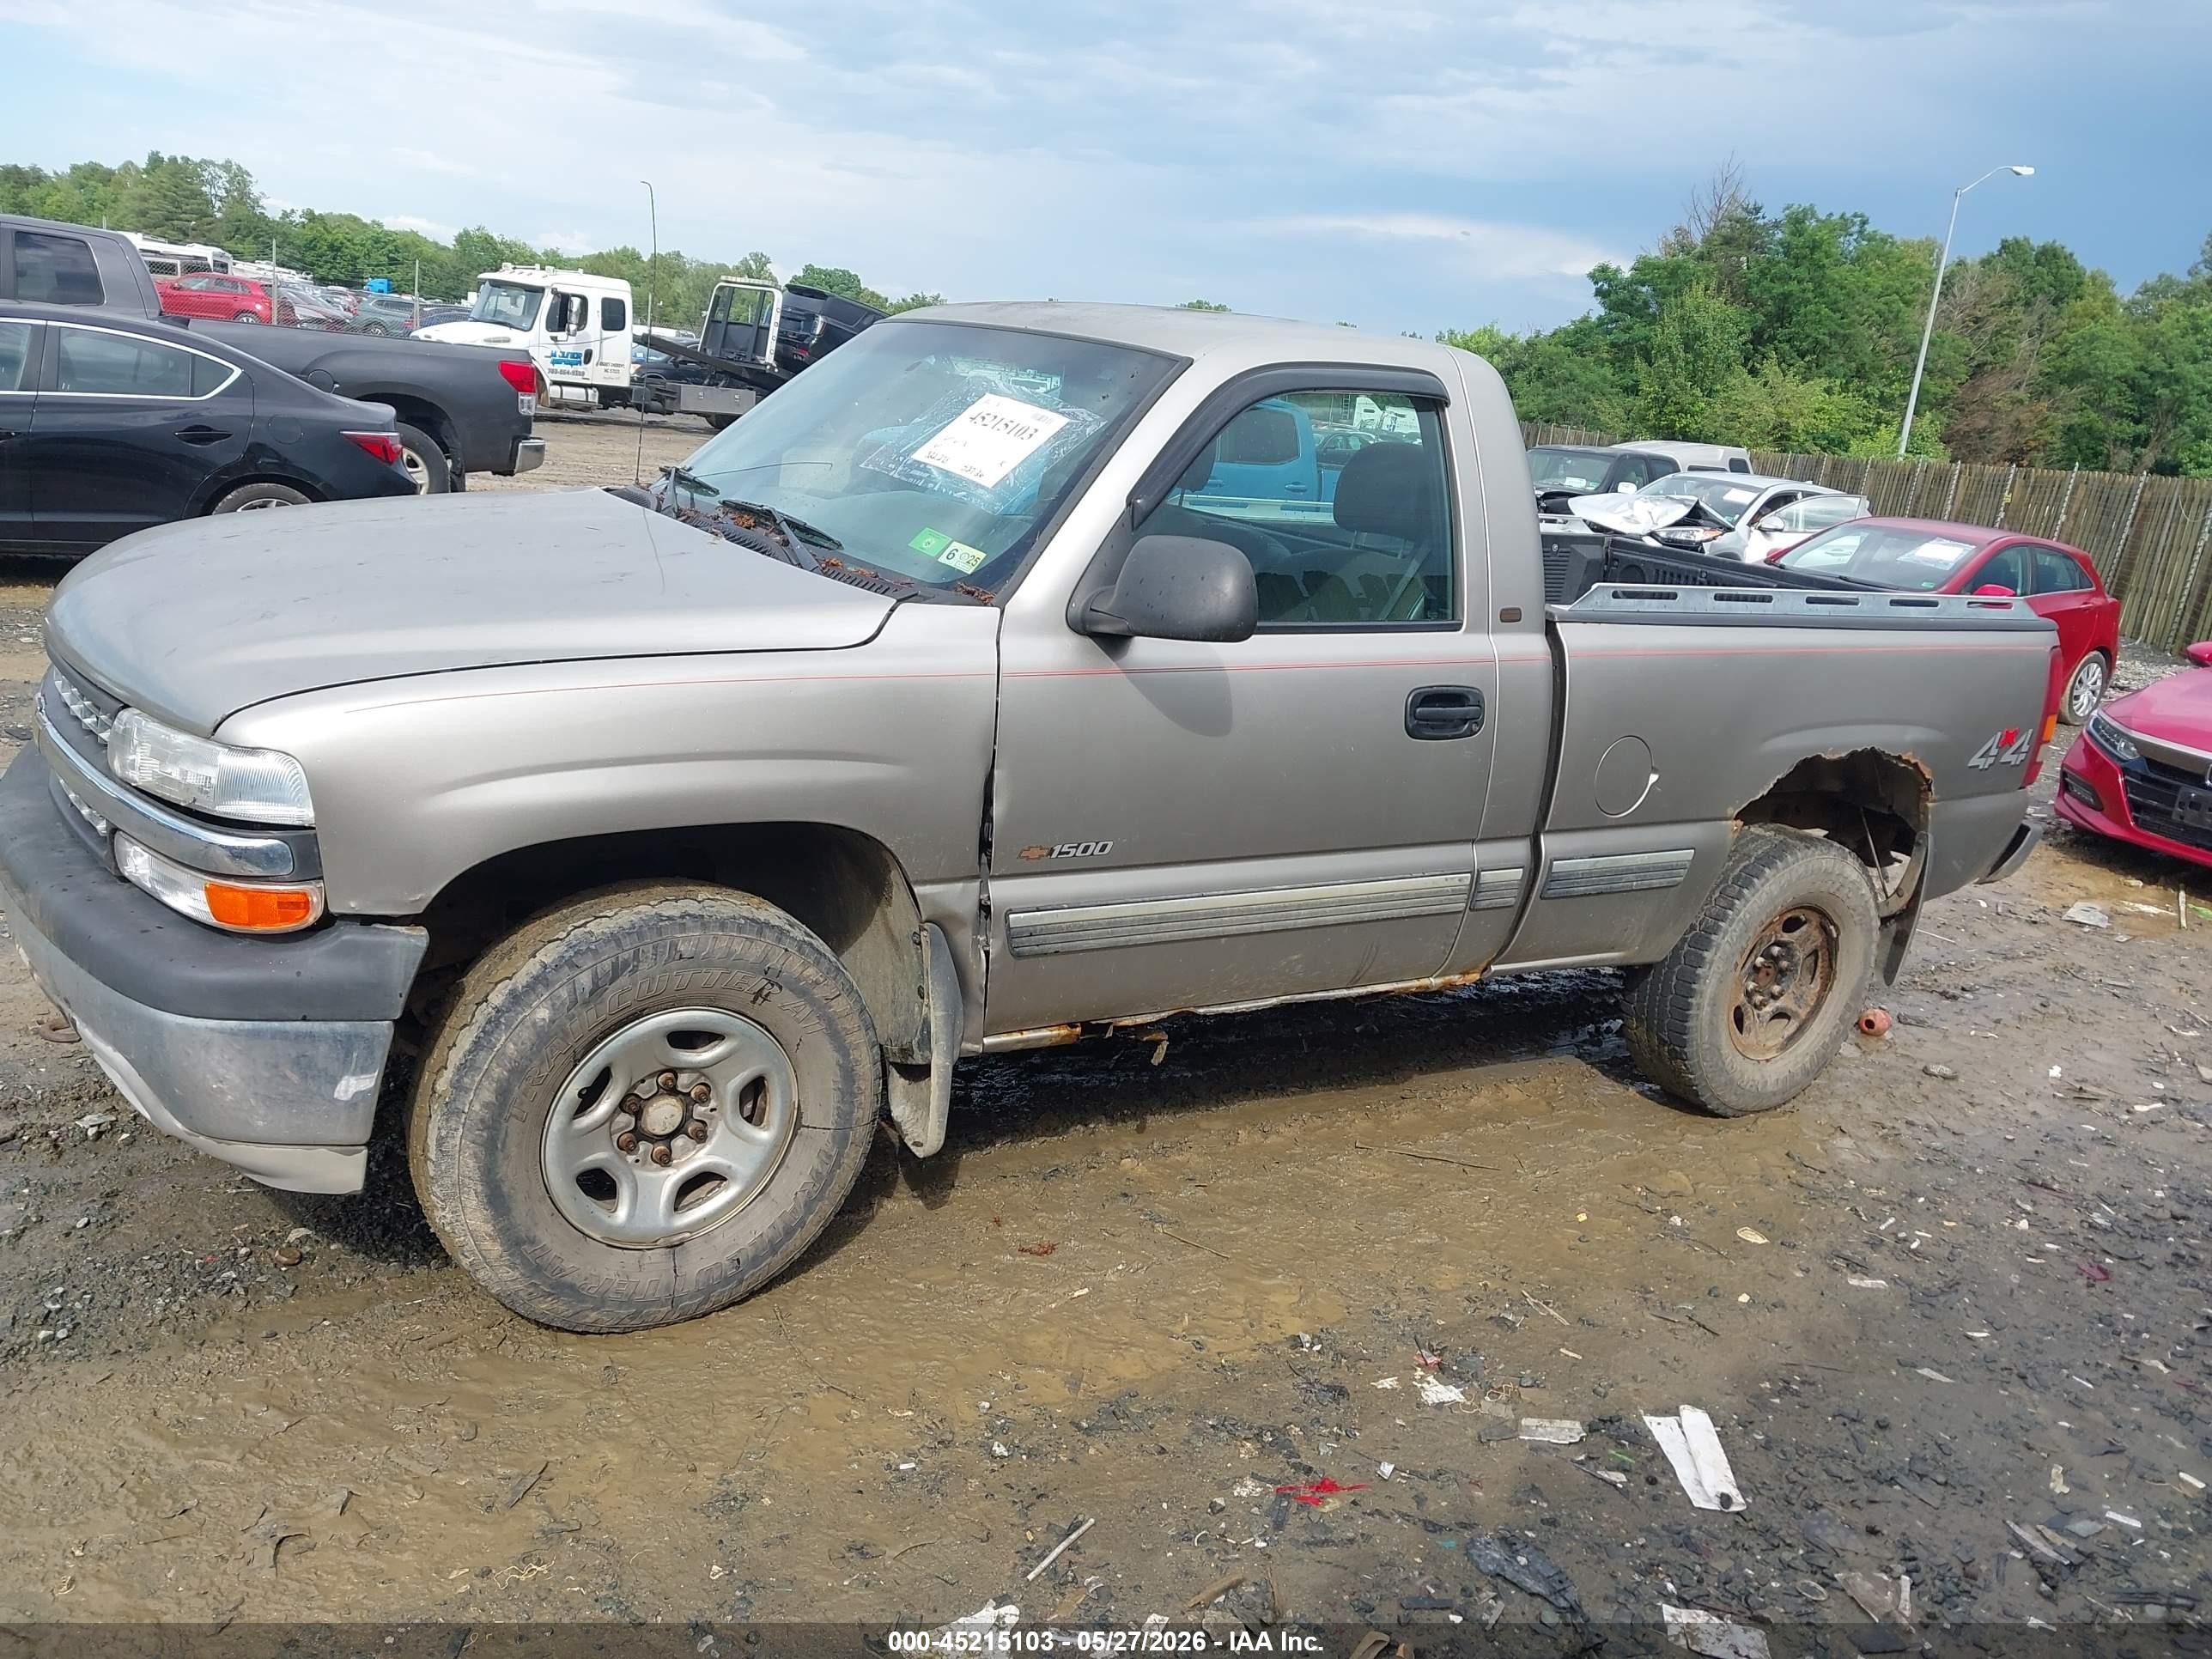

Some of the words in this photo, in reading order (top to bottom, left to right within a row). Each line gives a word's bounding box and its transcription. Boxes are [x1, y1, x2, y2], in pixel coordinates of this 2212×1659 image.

[969, 410, 1040, 441] 45215103
[945, 548, 959, 561] 6
[966, 554, 981, 568] 25
[1049, 840, 1114, 859] 1500
